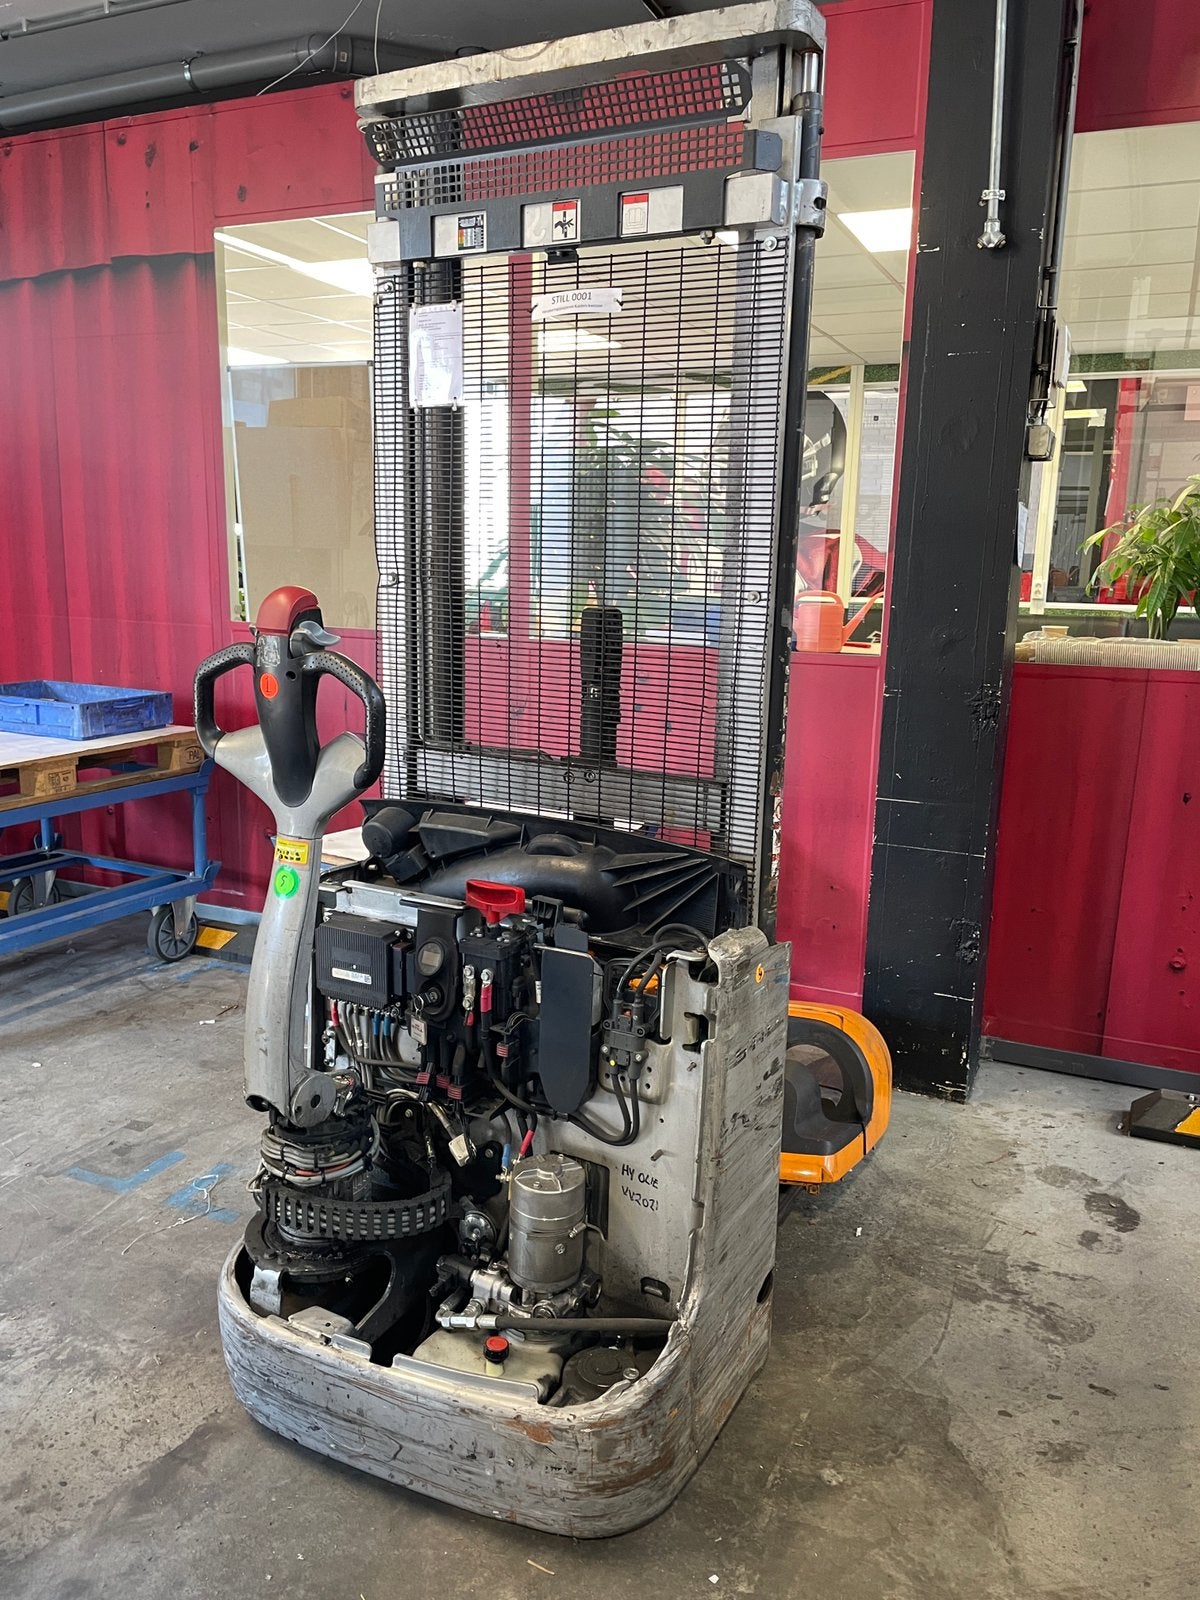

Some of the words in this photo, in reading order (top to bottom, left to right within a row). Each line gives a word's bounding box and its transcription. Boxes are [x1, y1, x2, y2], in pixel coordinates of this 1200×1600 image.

[551, 295, 570, 305] STILL
[571, 292, 592, 301] 0001
[621, 1163, 635, 1181] HY
